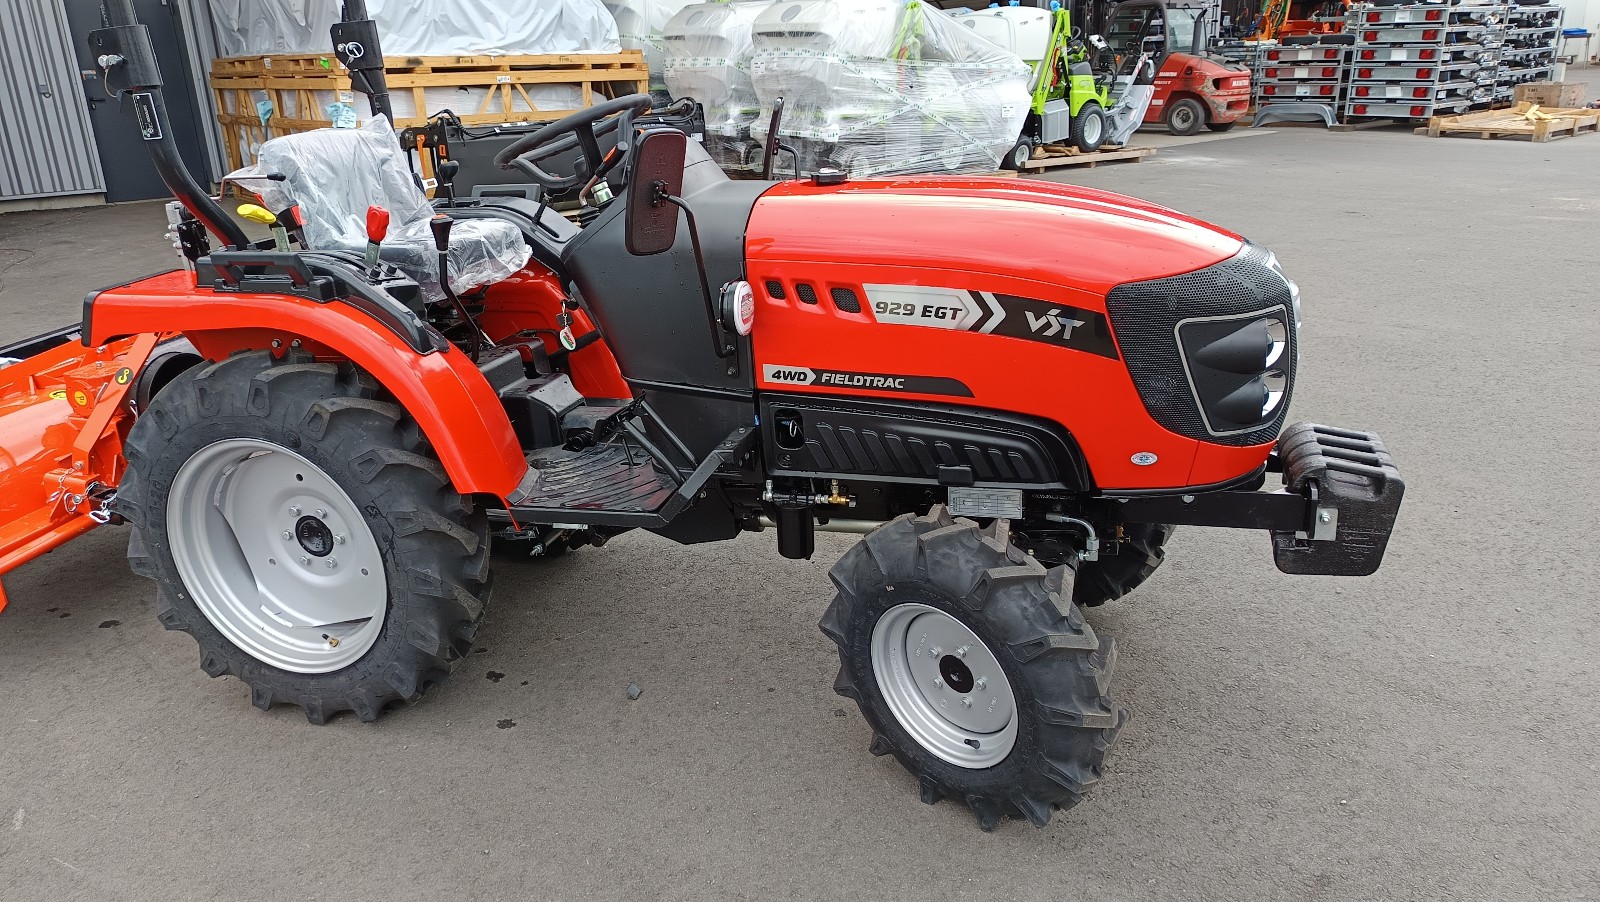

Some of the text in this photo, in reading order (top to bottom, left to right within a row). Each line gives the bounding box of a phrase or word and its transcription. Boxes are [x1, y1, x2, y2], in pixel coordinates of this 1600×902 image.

[875, 301, 963, 321] 929 EGT
[1024, 308, 1085, 340] VST
[771, 369, 905, 389] 4WD FIELDTRAC
